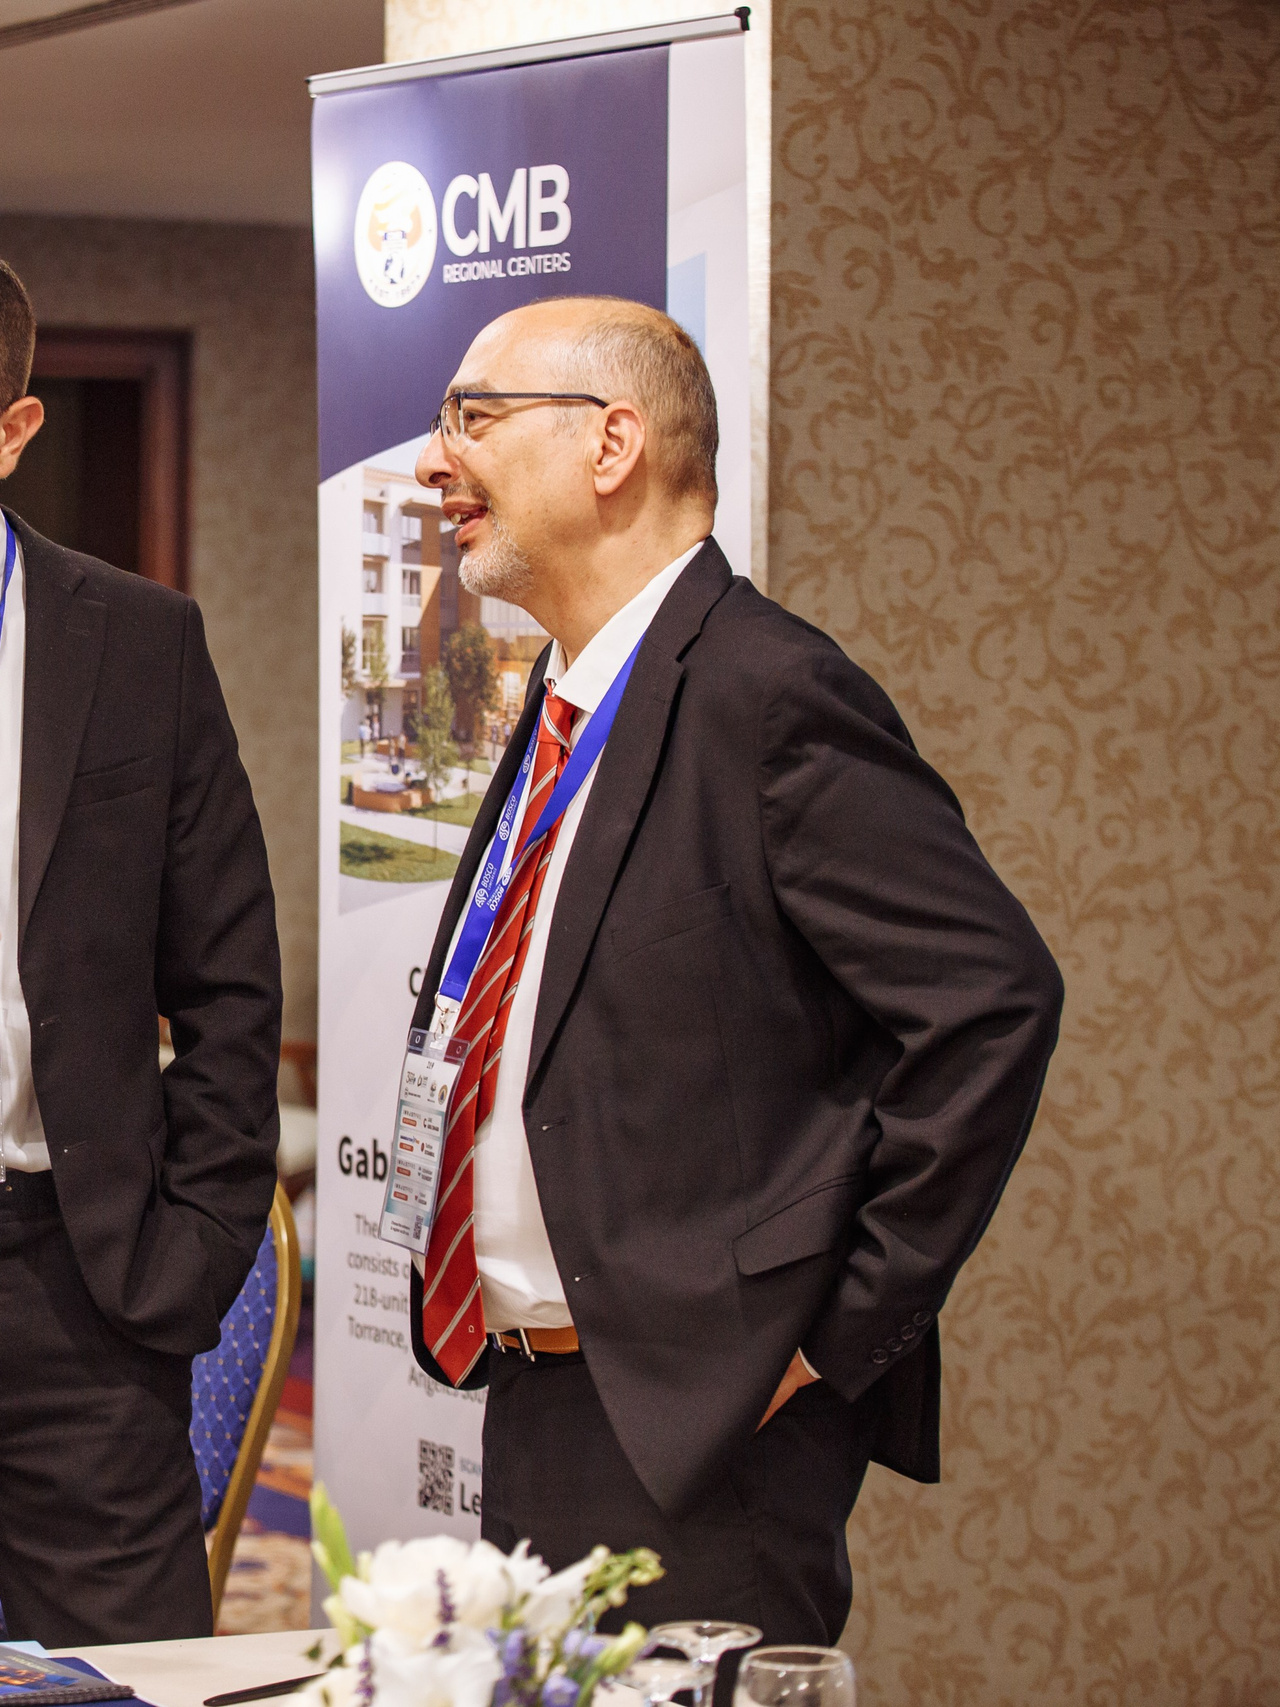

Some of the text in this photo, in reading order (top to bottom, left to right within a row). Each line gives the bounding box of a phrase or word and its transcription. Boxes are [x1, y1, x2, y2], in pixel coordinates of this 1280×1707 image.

[442, 164, 572, 257] CMB
[442, 252, 572, 284] REGIONAL CENTERS
[505, 795, 516, 820] BOSCO
[481, 863, 495, 888] BOSCO
[489, 886, 505, 911] BOSCO
[354, 1213, 379, 1239] The
[348, 1252, 399, 1278] consists
[348, 1315, 409, 1353] Torrance,
